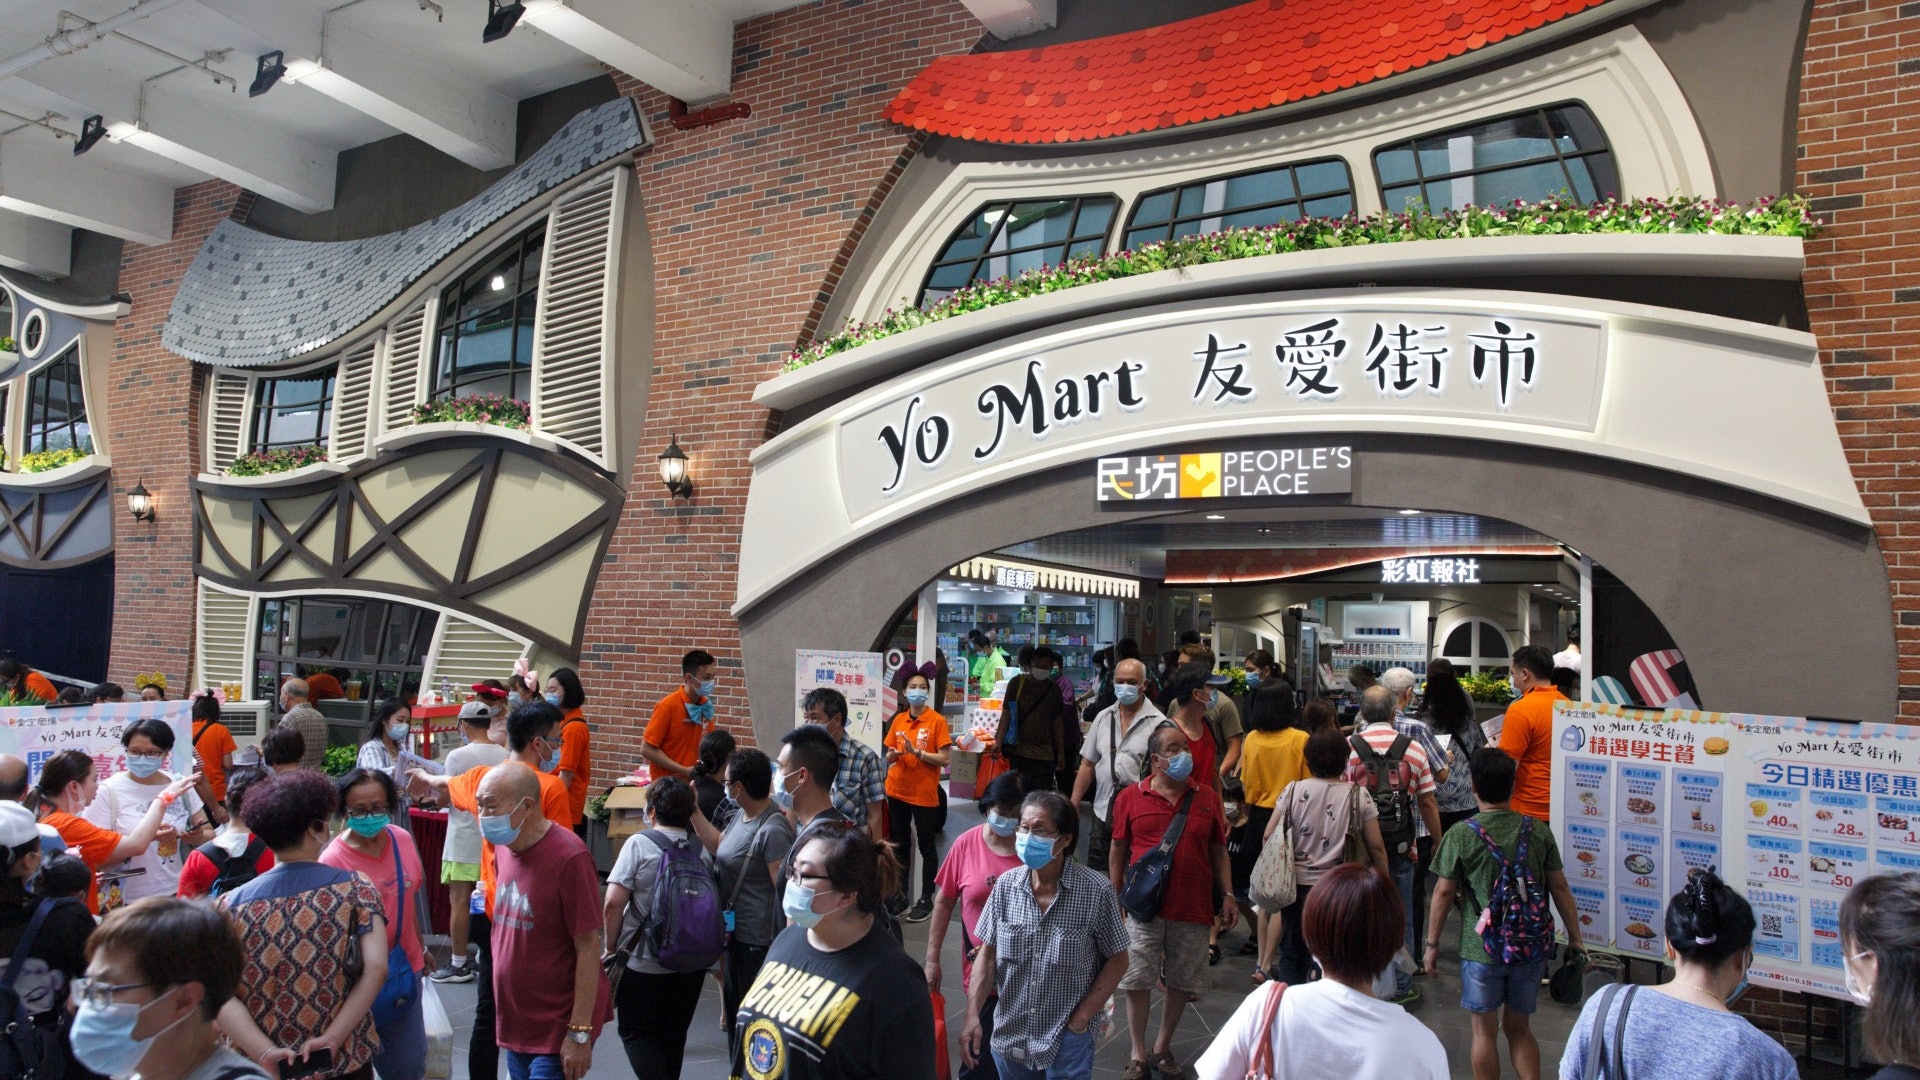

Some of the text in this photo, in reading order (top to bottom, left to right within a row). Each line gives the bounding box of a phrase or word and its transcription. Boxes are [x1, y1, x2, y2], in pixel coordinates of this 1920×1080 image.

[974, 360, 1143, 459] Mart
[1193, 317, 1535, 405] 友愛街市
[1224, 446, 1351, 473] PEOPLE'S
[1098, 456, 1177, 500] 民坊
[1224, 472, 1309, 496] PLACE
[1382, 559, 1479, 583] 彩虹報社
[816, 668, 864, 686] 開業嘉年華
[60, 727, 92, 742] Mart
[96, 725, 124, 740] 友愛
[1608, 721, 1635, 734] Mart
[1639, 721, 1695, 744] 友愛街市
[1589, 736, 1695, 764] 精選學生餐
[1796, 740, 1828, 754] Mart
[1833, 740, 1903, 765] 友愛街市
[1762, 763, 1918, 798] 今日精選優惠
[738, 961, 861, 1048] ICHIGAM
